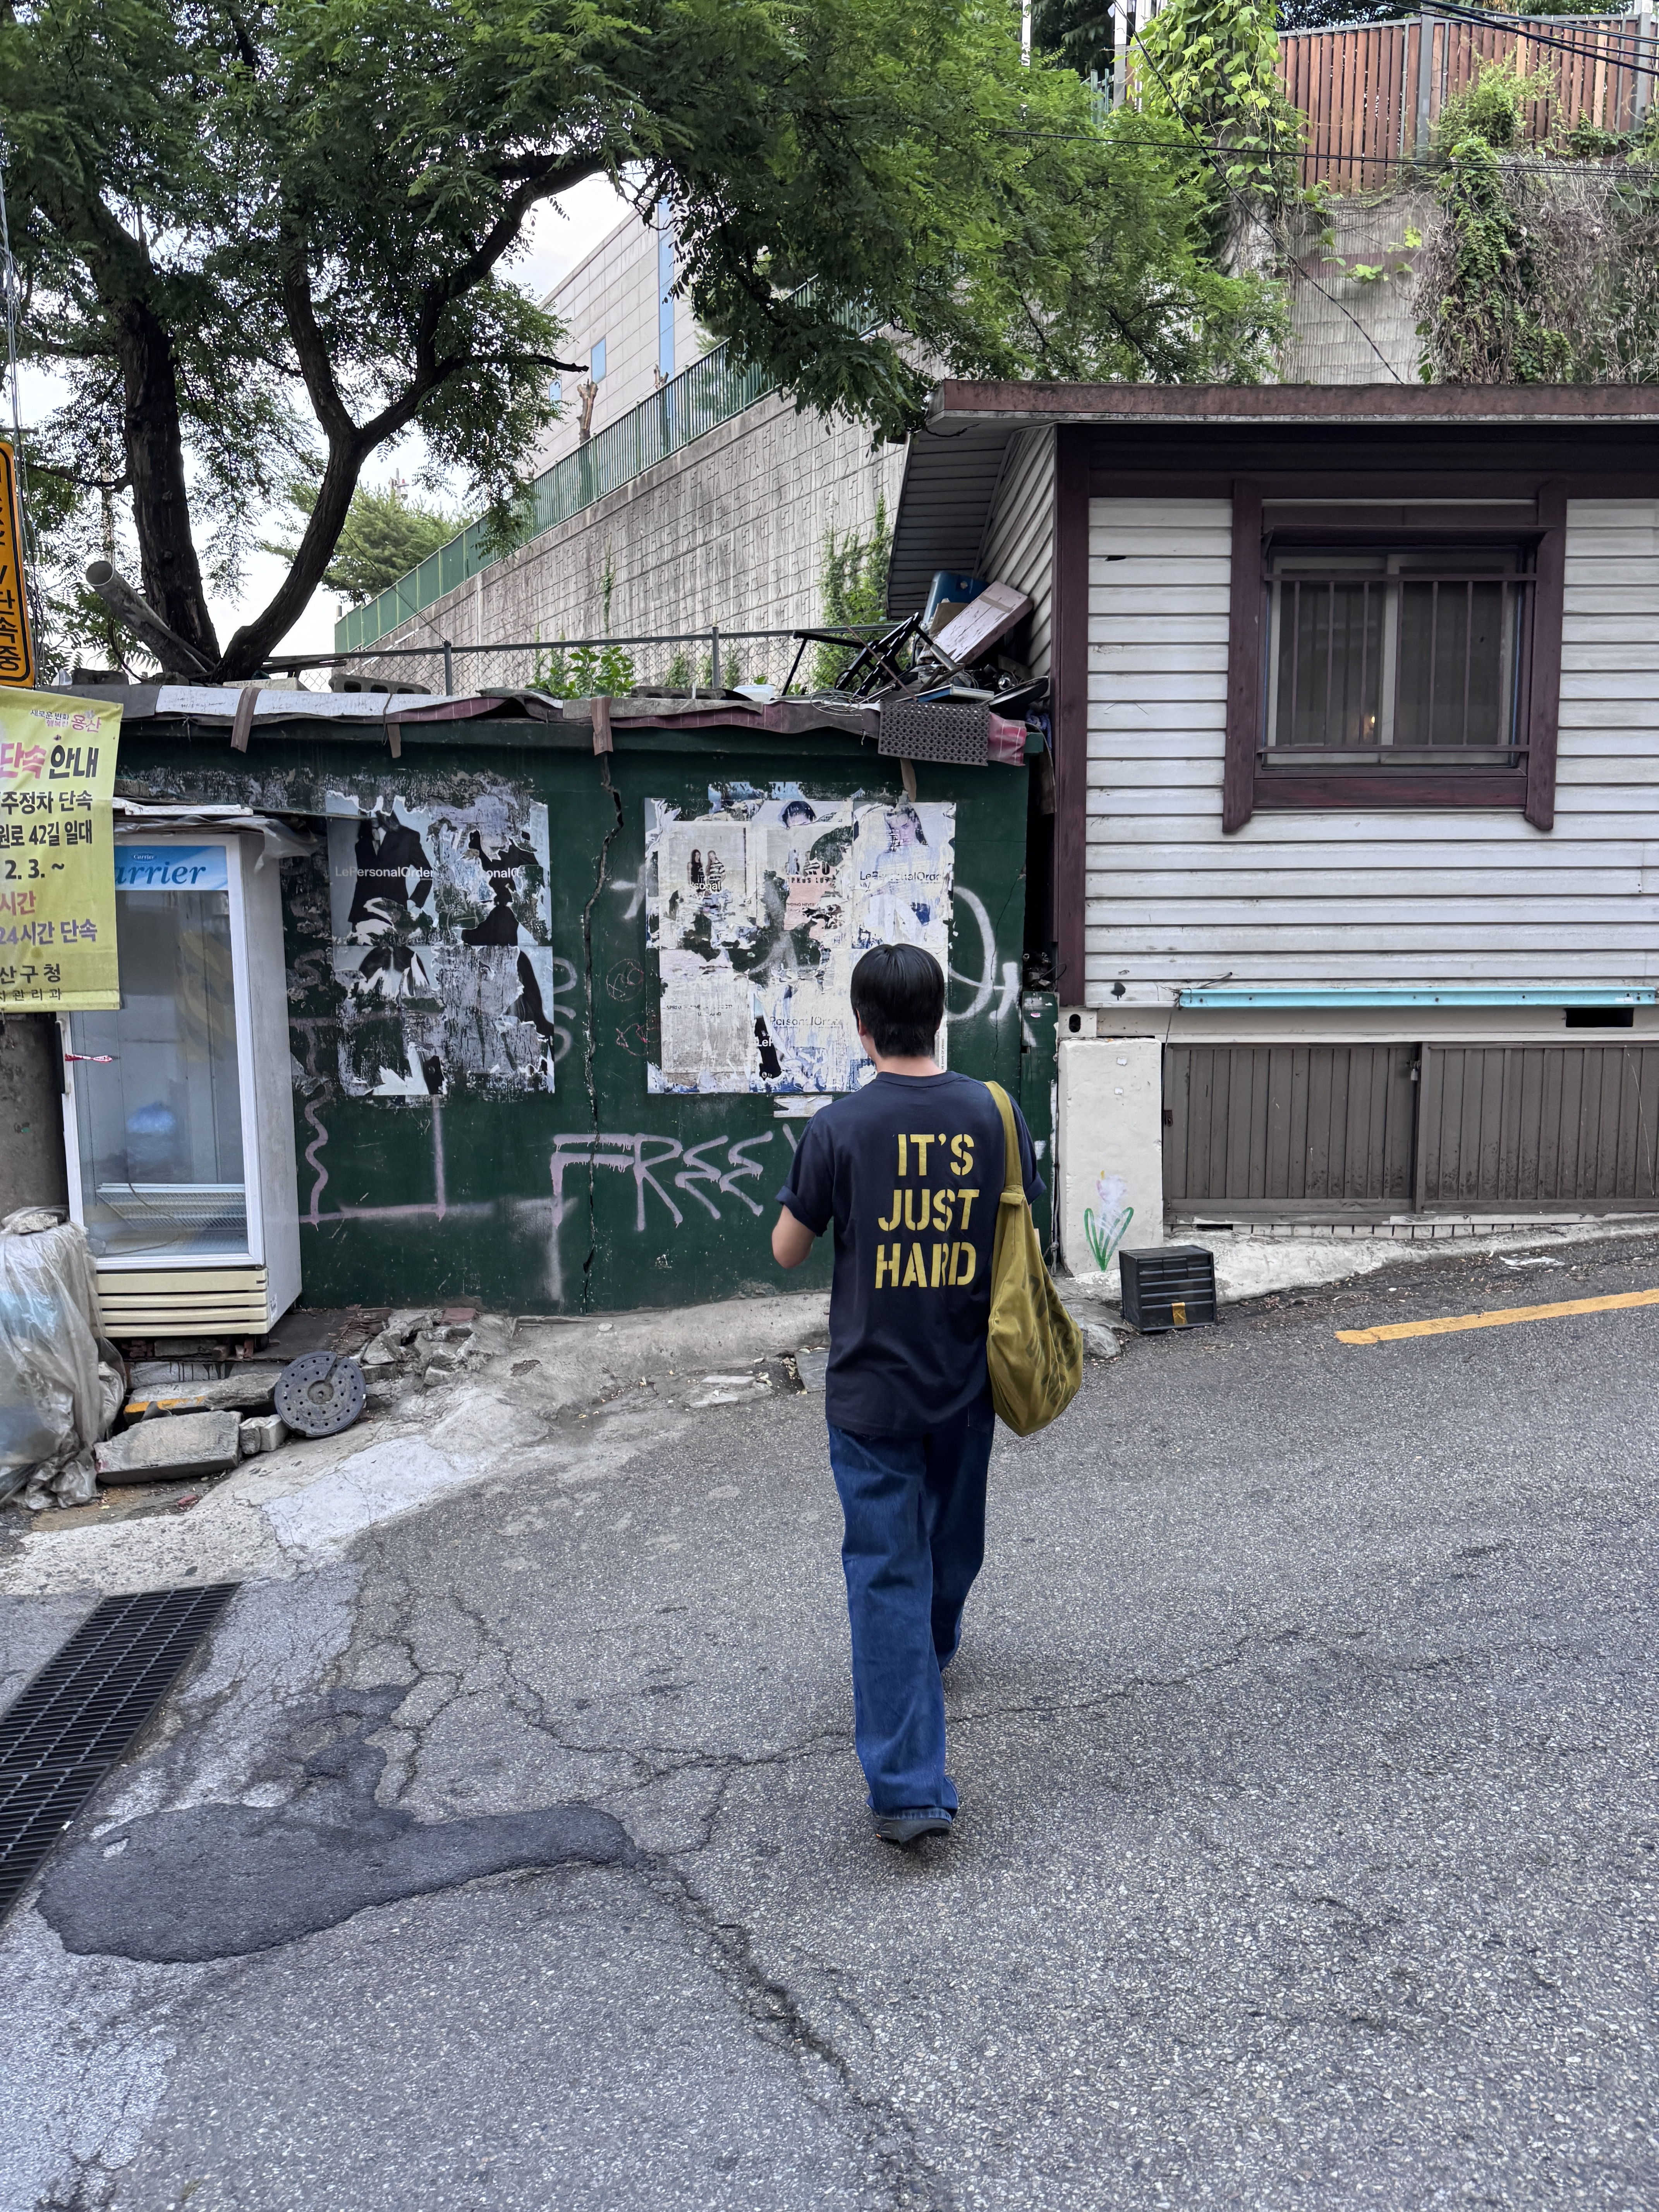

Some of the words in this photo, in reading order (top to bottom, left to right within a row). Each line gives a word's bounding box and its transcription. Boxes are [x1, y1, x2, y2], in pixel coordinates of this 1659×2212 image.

[71, 714, 102, 733] 용산
[0, 742, 47, 779] 단속
[49, 745, 100, 780] 안내
[0, 791, 54, 815] 주정차
[59, 790, 93, 812] 단속
[29, 821, 60, 847] 42길
[64, 819, 93, 845] 일대
[0, 890, 36, 916] 시간
[0, 921, 55, 946] 24시간
[60, 918, 98, 944] 단속
[898, 1133, 974, 1176] IT'S
[878, 1189, 980, 1232] JUST
[875, 1242, 977, 1289] HARD
